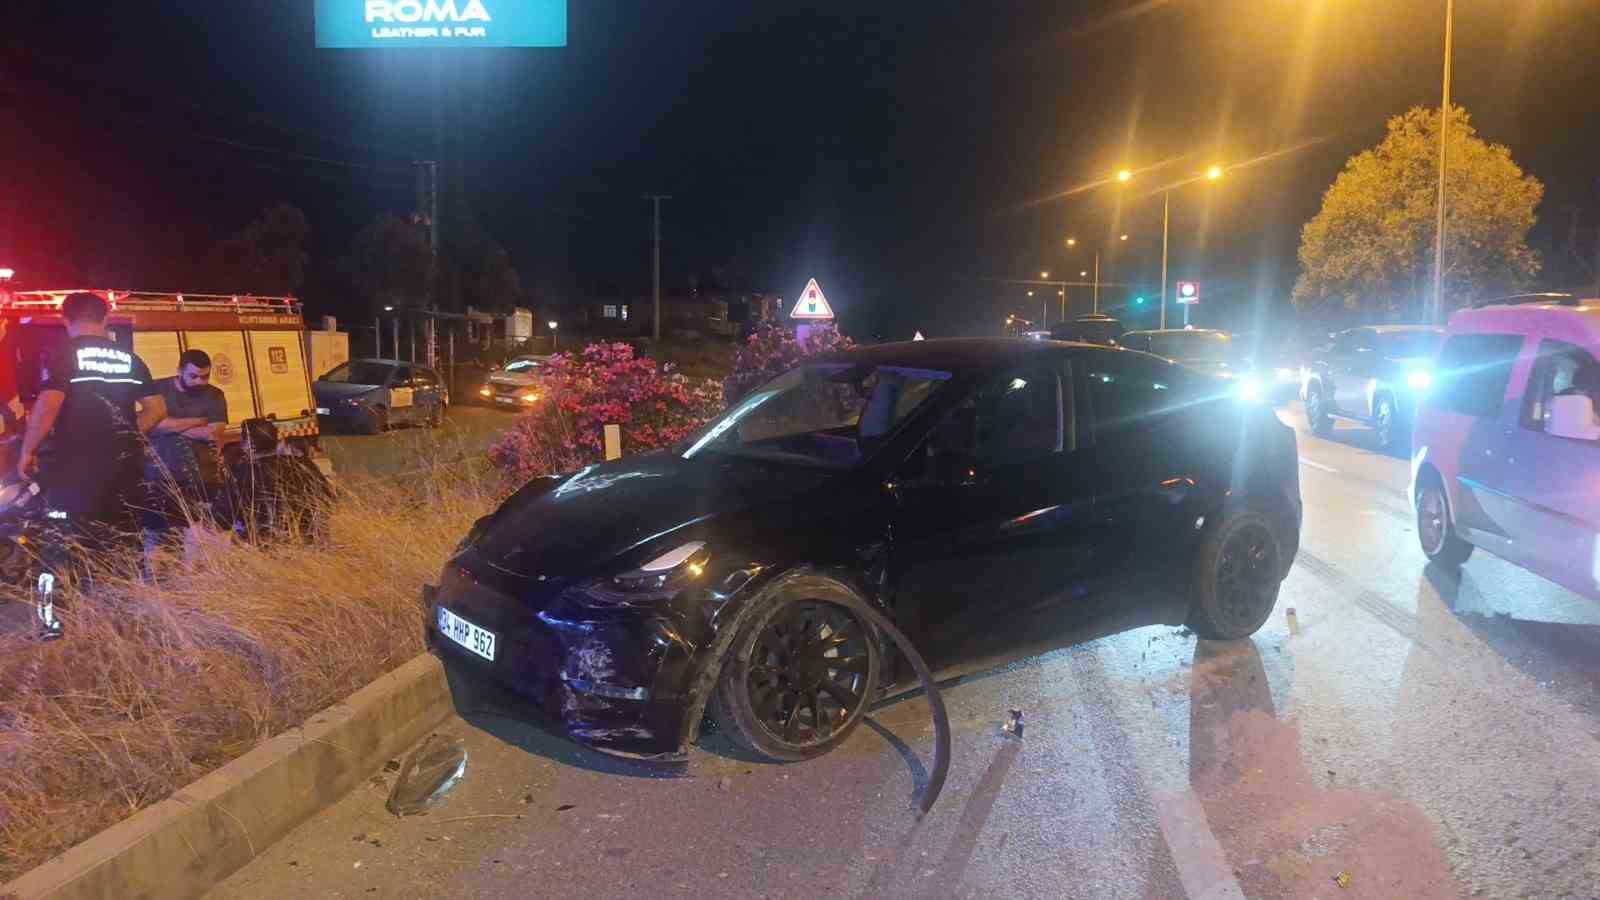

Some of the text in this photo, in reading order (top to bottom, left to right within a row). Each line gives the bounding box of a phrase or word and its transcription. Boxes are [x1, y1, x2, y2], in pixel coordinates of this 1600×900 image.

[365, 0, 492, 22] ROMA
[371, 27, 486, 38] LEATHER & FUR
[454, 618, 470, 644] HHP
[474, 629, 492, 656] 962
